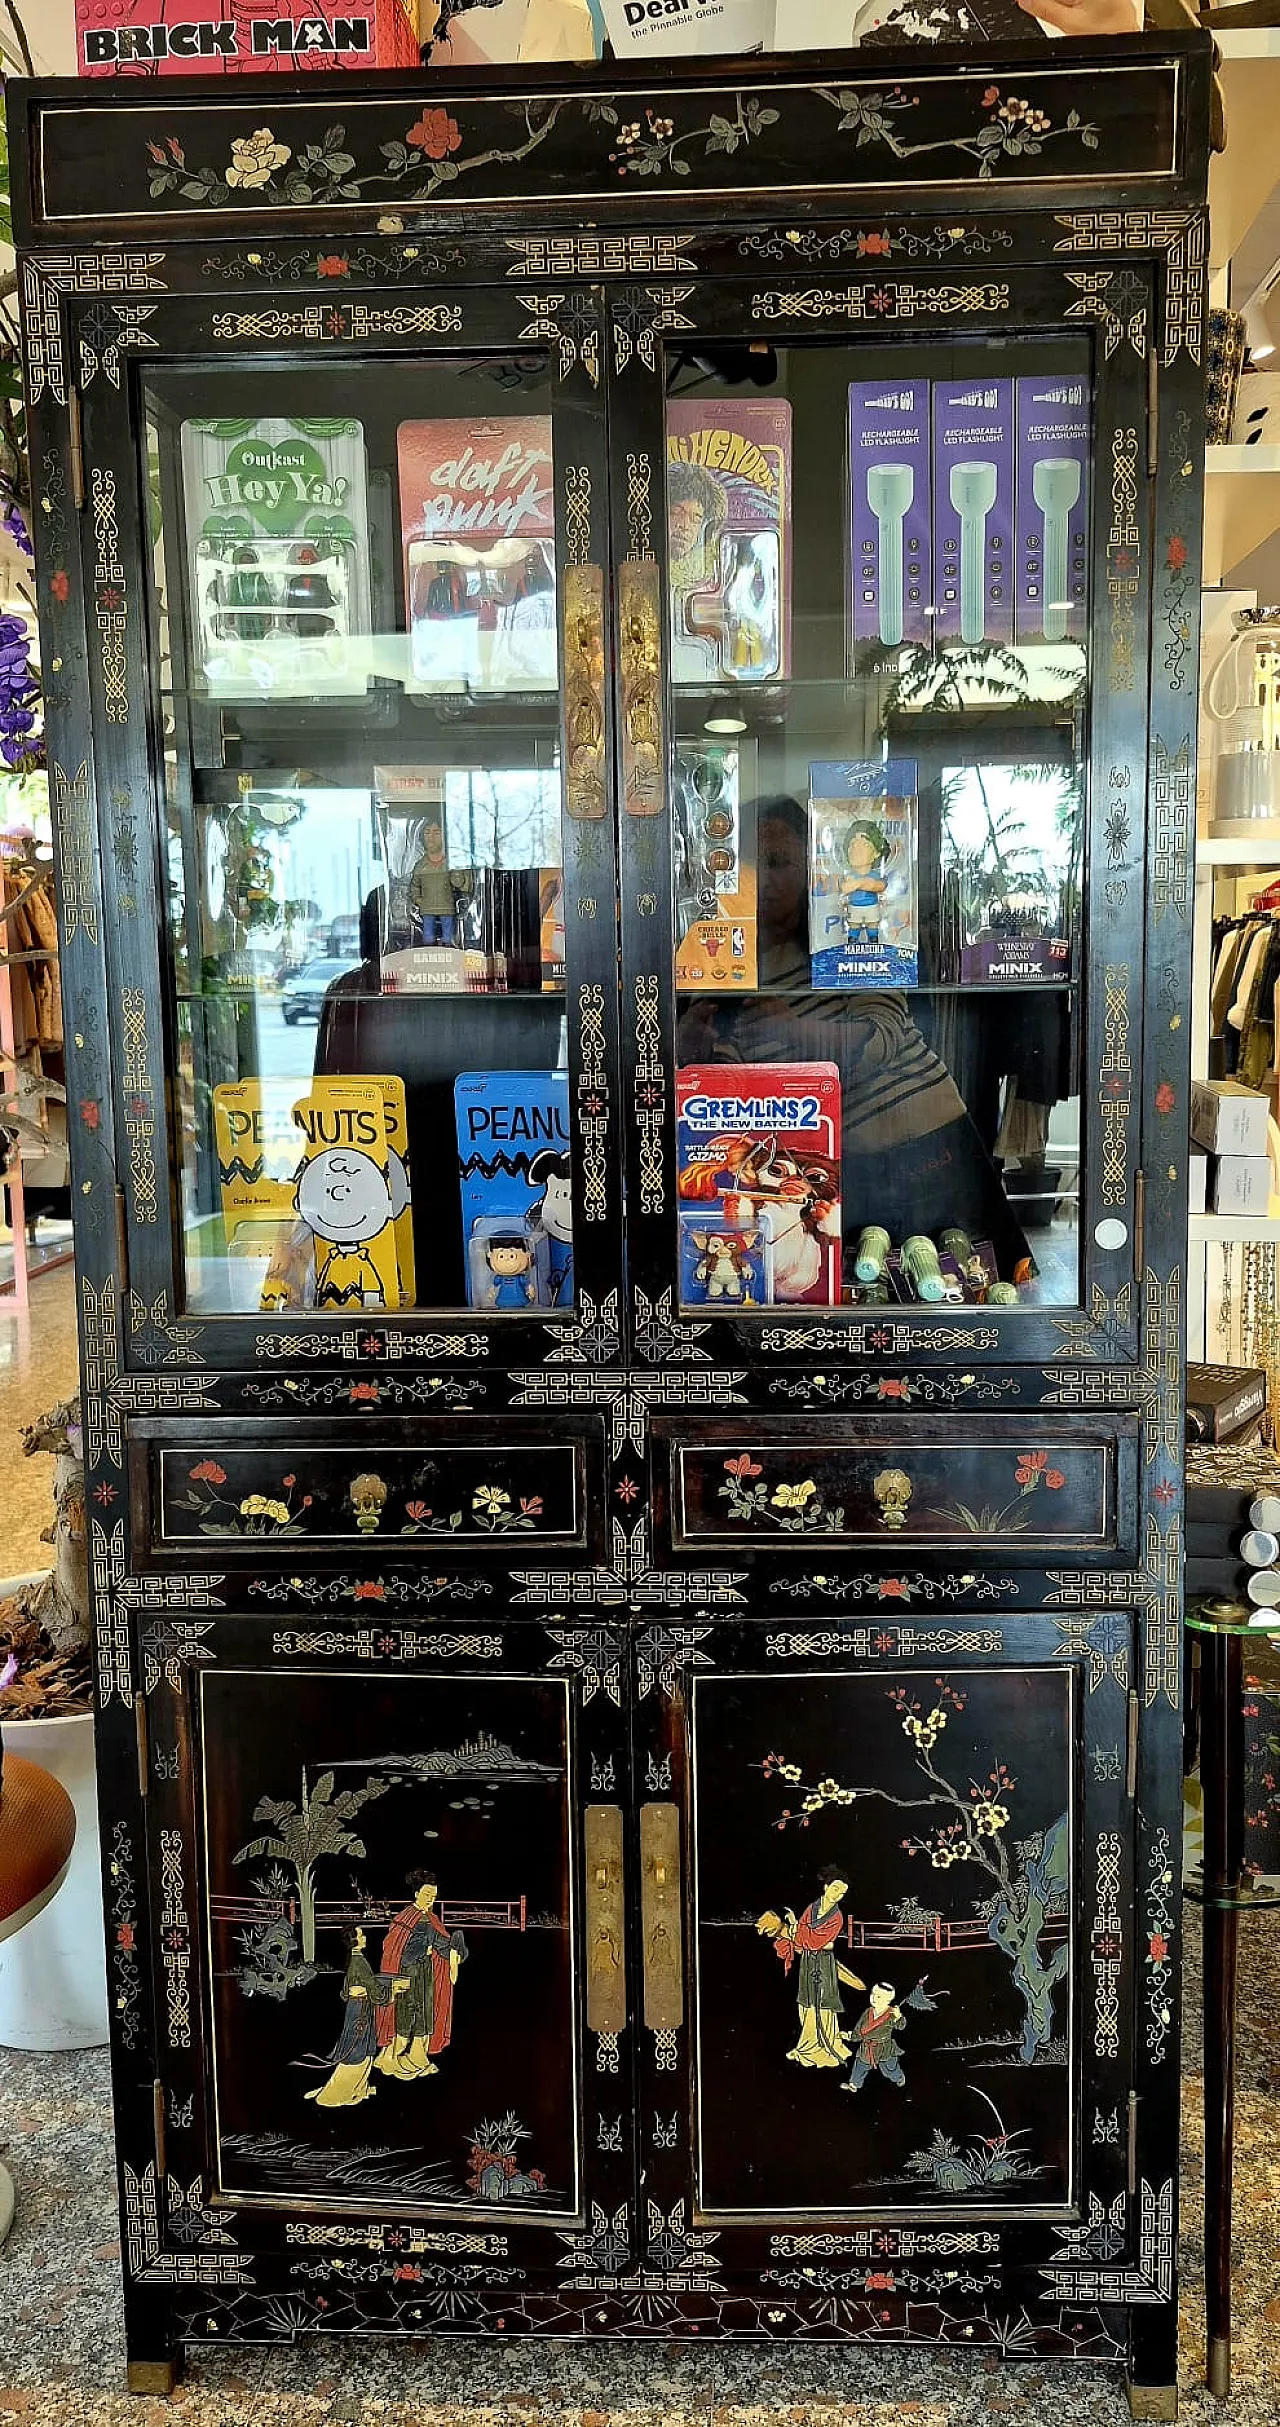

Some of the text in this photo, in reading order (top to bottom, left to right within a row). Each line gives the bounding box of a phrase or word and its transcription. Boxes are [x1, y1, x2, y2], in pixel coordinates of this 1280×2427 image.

[631, 5, 724, 39] the Pinnable Globe
[84, 17, 374, 65] BRICK MAN
[861, 429, 919, 439] RECHARGEABLE
[944, 427, 1003, 437] RECHARGEABLE
[1027, 433, 1042, 442] LED
[860, 436, 920, 446] LED FLASHLIGHT
[943, 434, 1004, 446] LED FLASHLIGHT
[430, 441, 553, 498] daft
[204, 471, 348, 509] Hey Ya!
[423, 473, 553, 539] punk
[837, 962, 891, 973] MINIX
[988, 962, 1043, 975] MINIX
[405, 972, 460, 984] MINIX
[800, 1099, 818, 1128] 2
[692, 1120, 797, 1128] THE NEW BATCH
[687, 1151, 728, 1162] GIZMO
